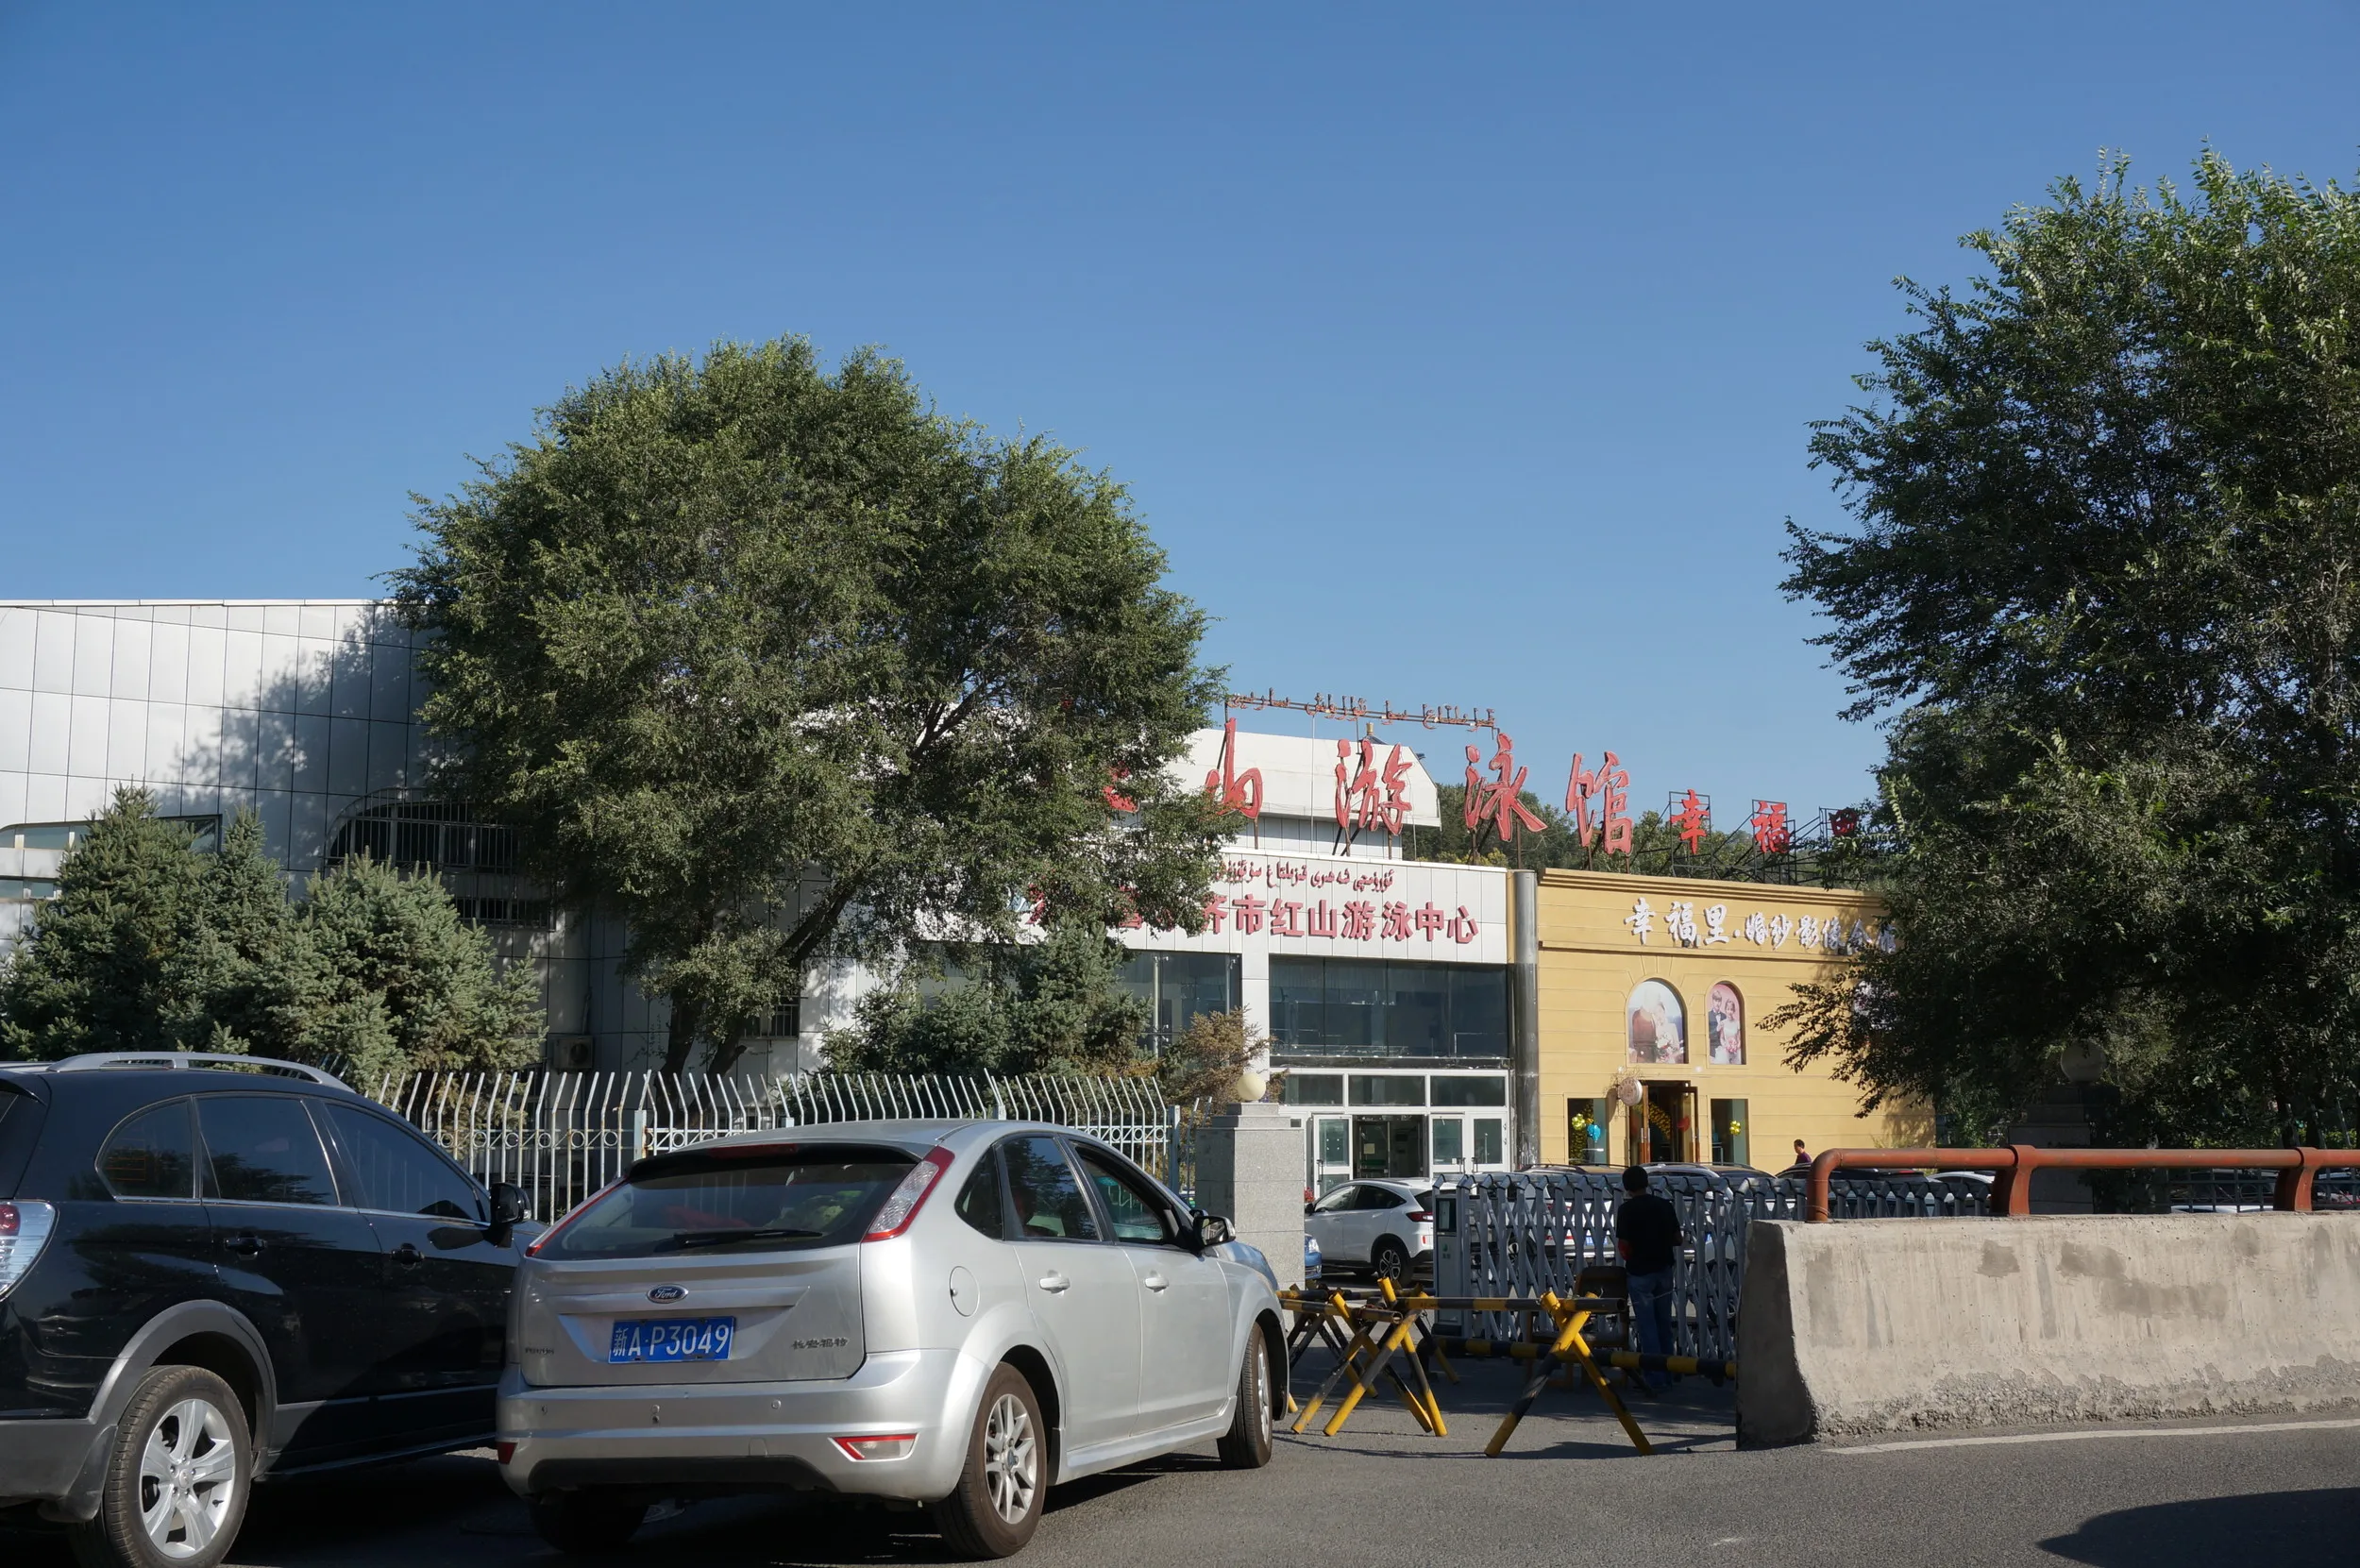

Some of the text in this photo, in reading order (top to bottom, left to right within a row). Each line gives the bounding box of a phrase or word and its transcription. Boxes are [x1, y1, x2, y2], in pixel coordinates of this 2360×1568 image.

[1102, 717, 1634, 855] 山游泳馆
[1118, 885, 1479, 944] 齐市红山游泳中心
